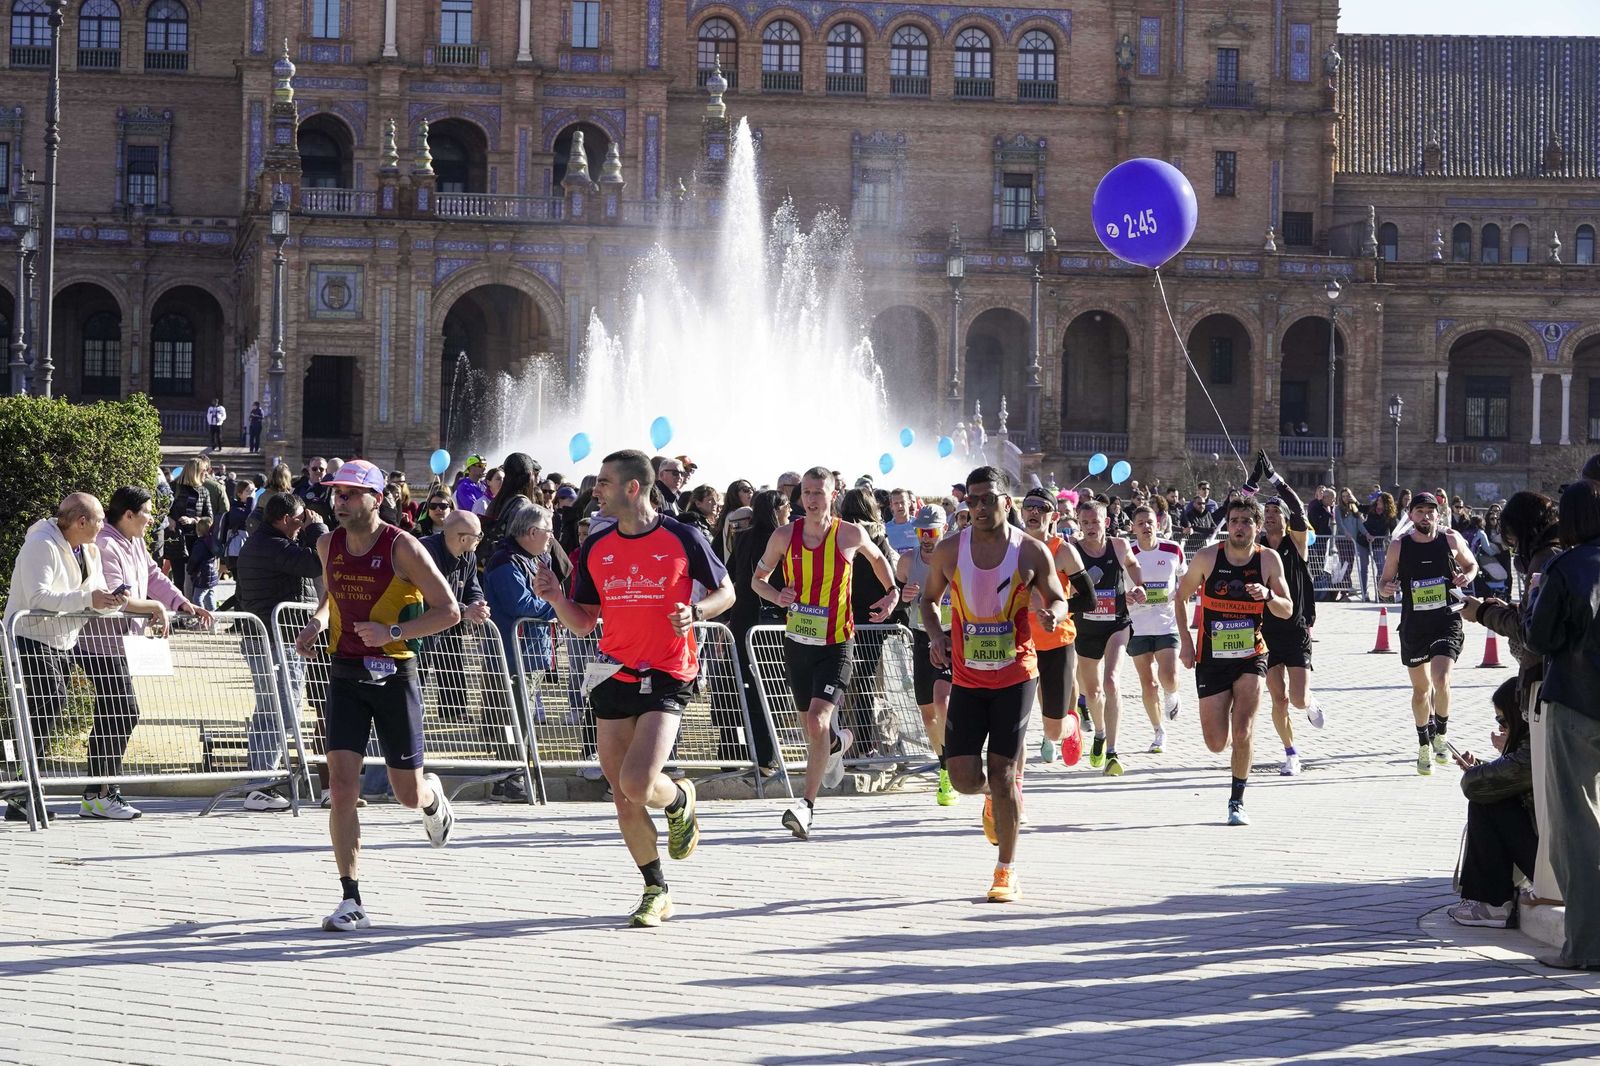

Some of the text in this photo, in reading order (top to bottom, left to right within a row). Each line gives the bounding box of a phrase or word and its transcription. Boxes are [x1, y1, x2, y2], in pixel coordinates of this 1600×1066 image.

[1123, 208, 1157, 239] 2:45
[1421, 578, 1443, 587] ZURICH
[341, 584, 363, 593] VINO
[348, 592, 372, 601] TORO
[1417, 594, 1442, 603] REANEY
[800, 606, 825, 616] ZURICH
[979, 625, 1008, 633] ZURICH
[1225, 621, 1250, 629] ZURICH
[795, 624, 817, 637] CHRIS
[980, 640, 997, 648] 2583
[1223, 641, 1245, 650] FRUN
[973, 649, 1006, 660] ARJUN
[371, 661, 395, 670] URICH
